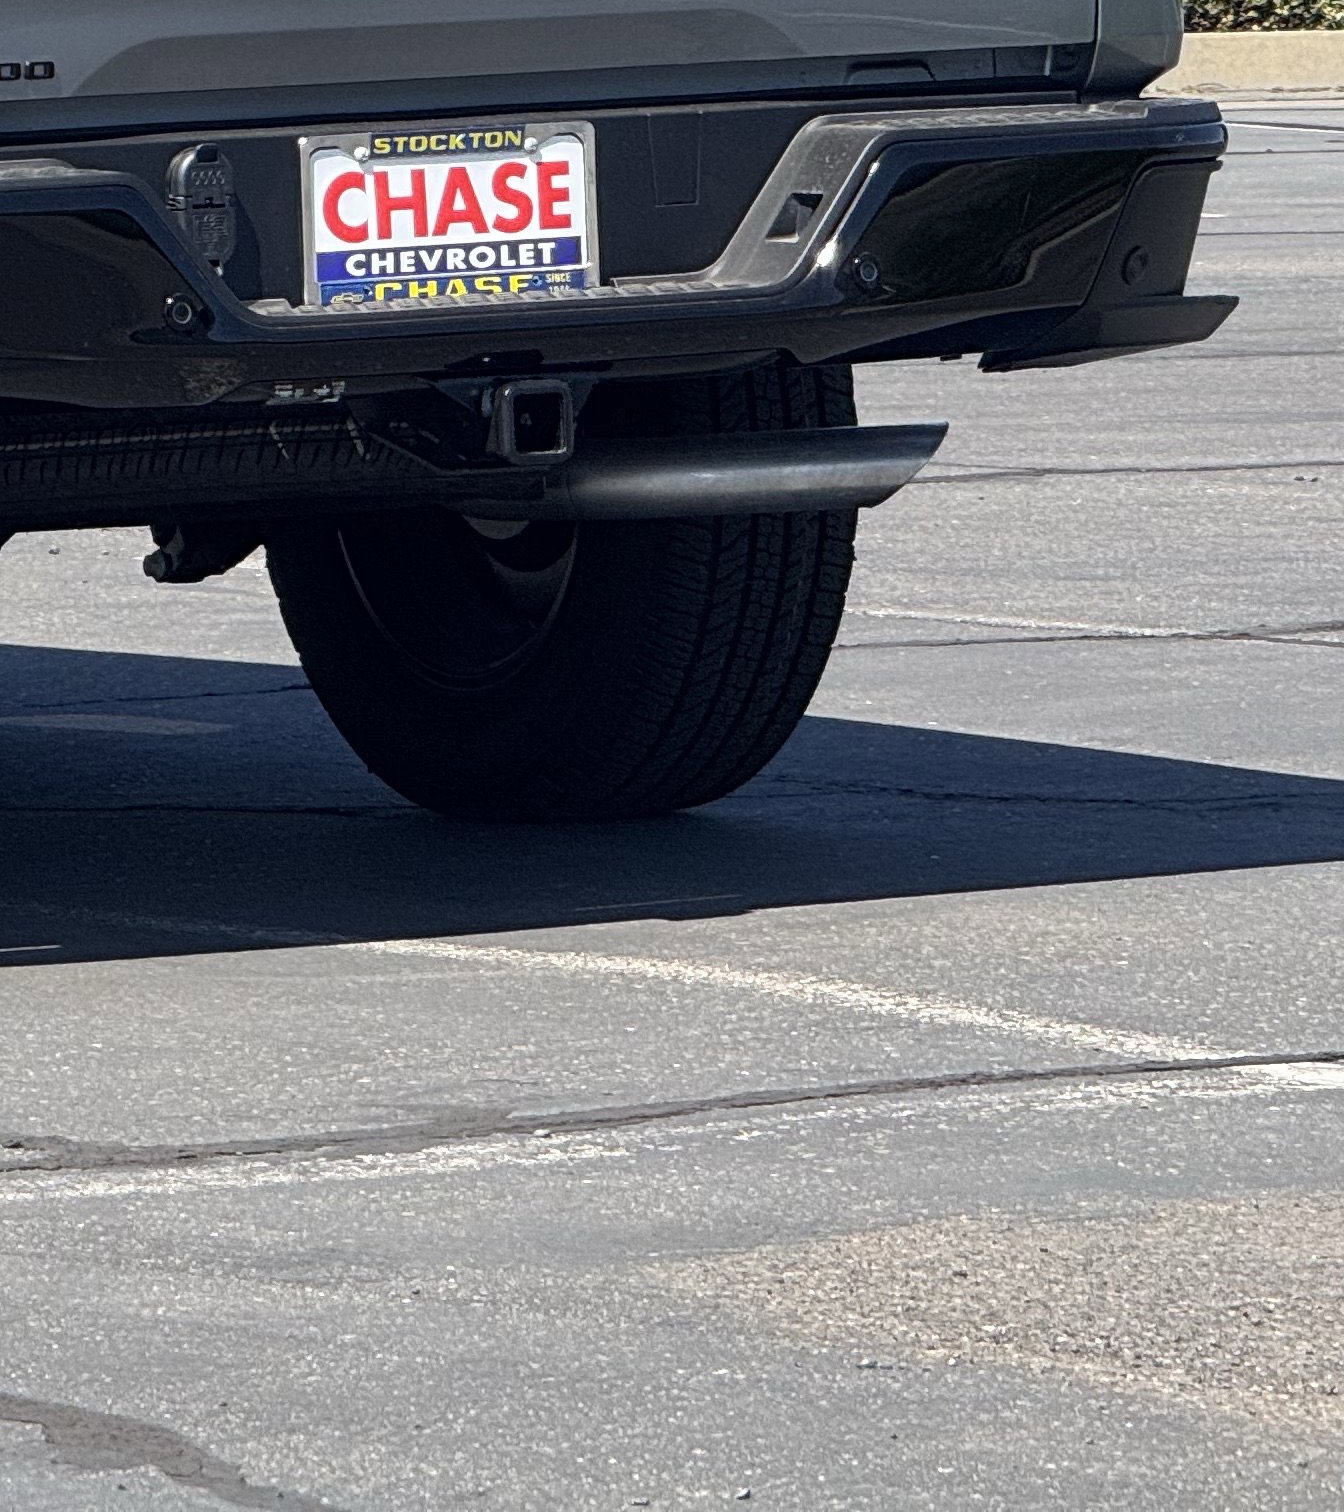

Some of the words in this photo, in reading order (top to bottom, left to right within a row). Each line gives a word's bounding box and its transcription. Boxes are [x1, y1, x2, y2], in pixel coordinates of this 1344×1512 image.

[374, 129, 522, 154] STOCKTON
[322, 161, 572, 243] CHASE
[346, 241, 556, 277] CHEVROLET
